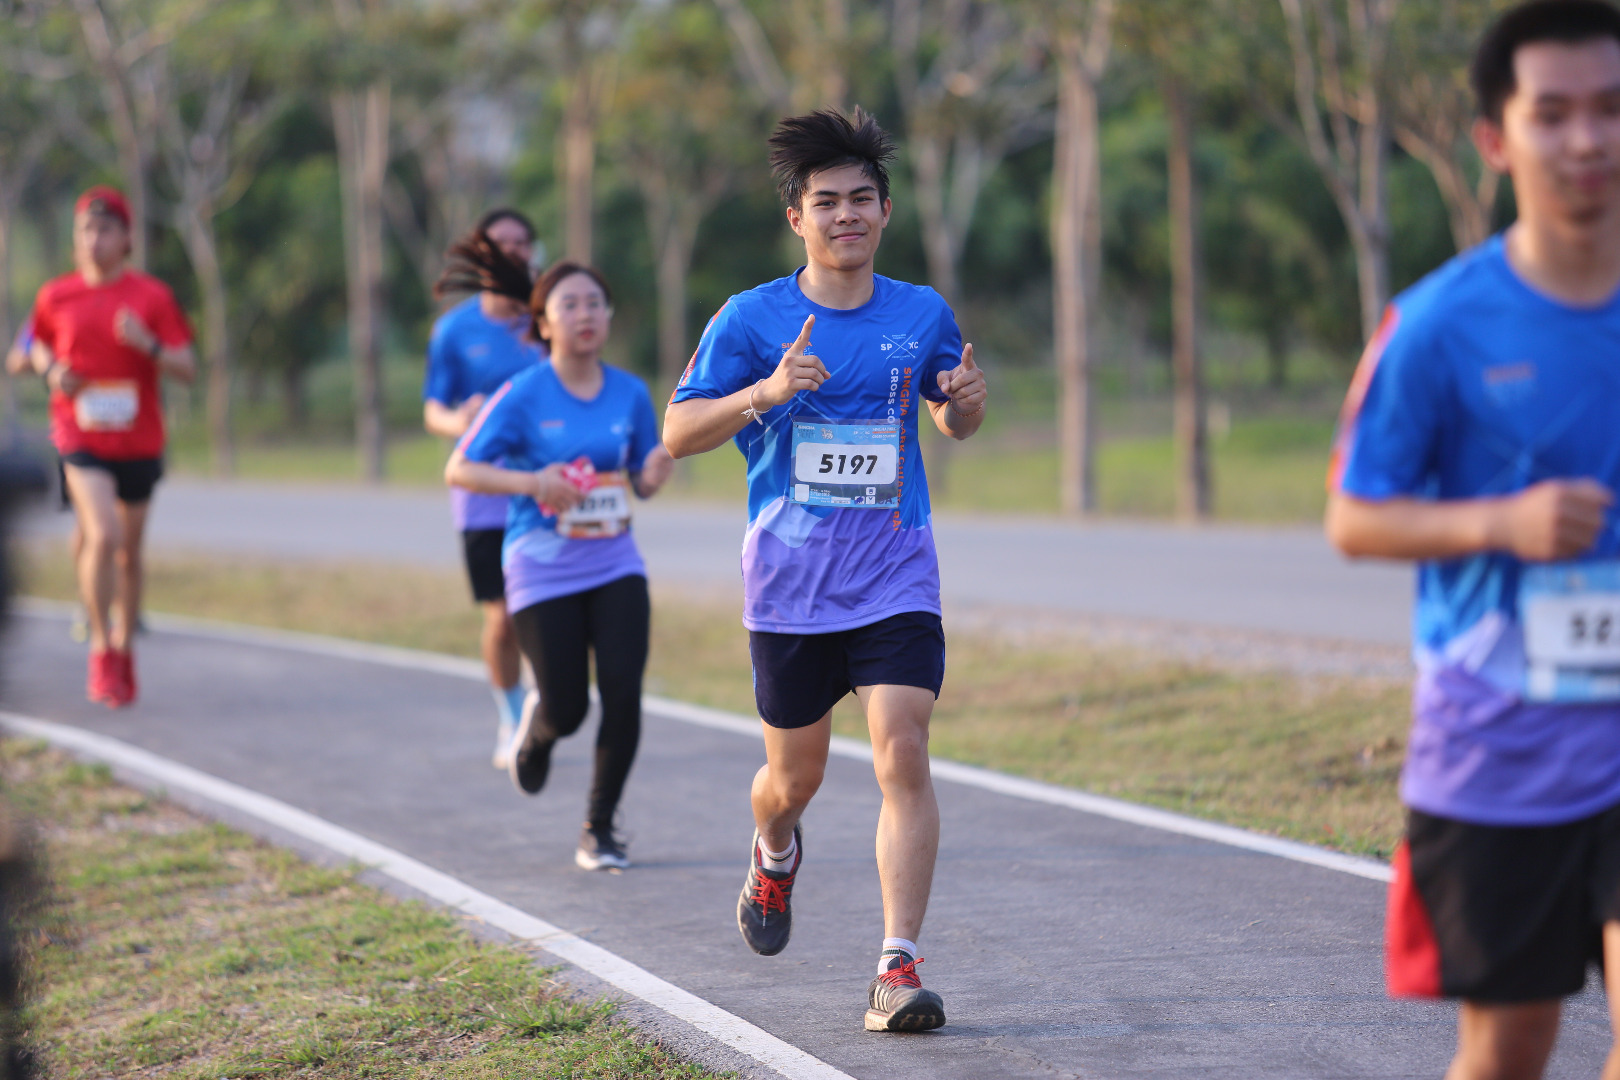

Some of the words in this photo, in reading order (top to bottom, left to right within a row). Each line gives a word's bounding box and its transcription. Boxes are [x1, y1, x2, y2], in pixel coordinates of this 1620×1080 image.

[880, 343, 892, 351] SP
[908, 341, 919, 350] XC
[888, 367, 899, 404] CROSS
[900, 367, 912, 416] SINGHA
[819, 453, 878, 475] 5197
